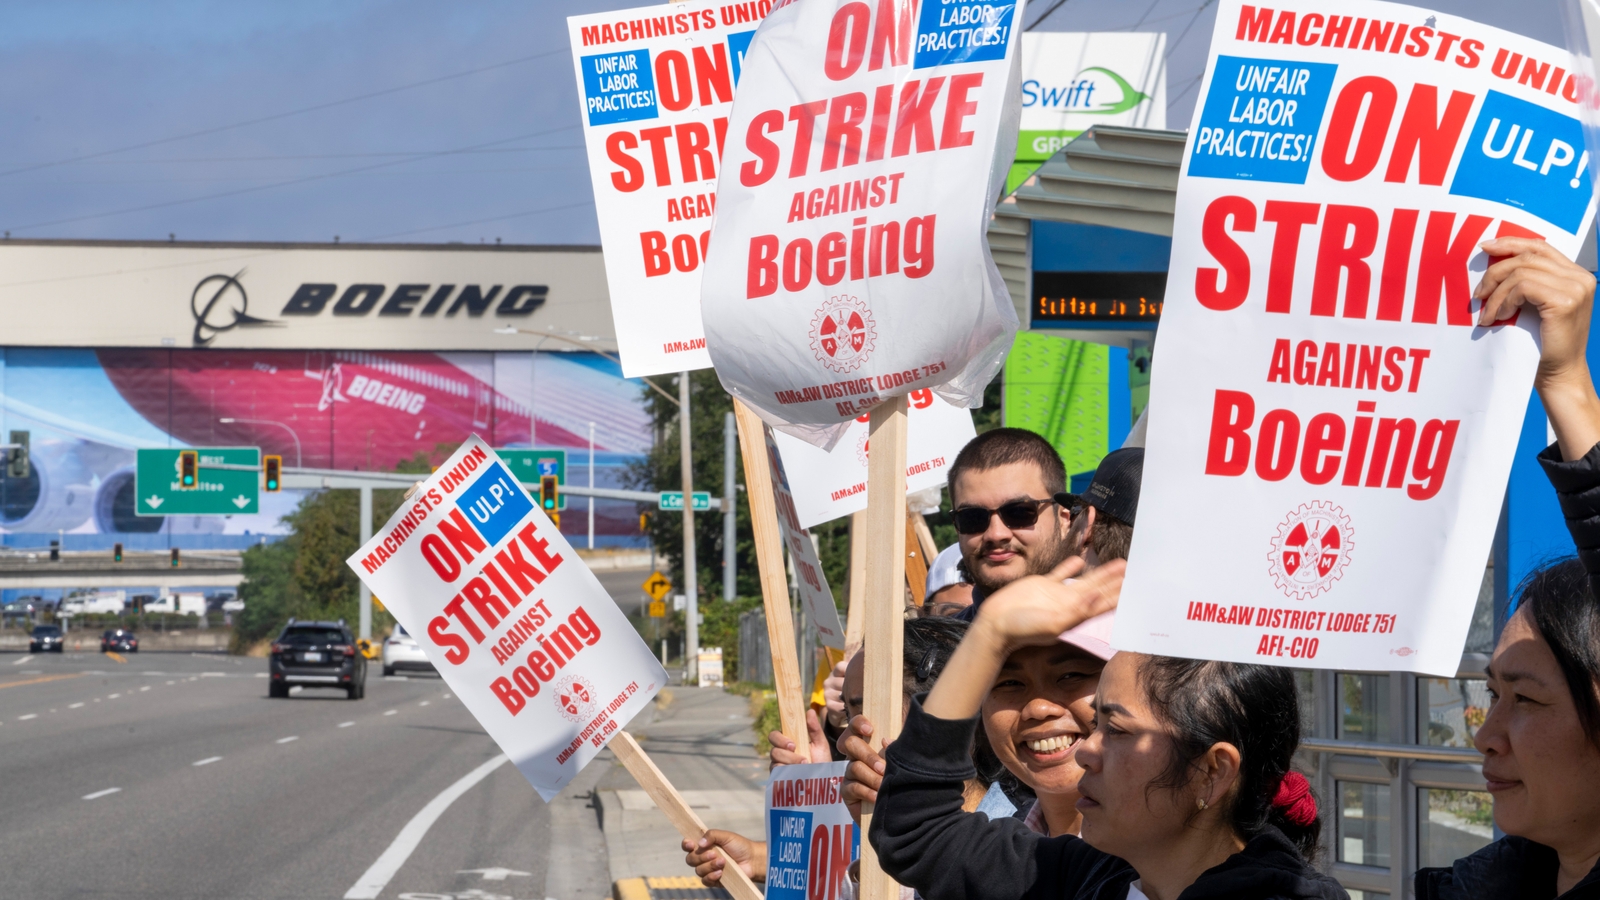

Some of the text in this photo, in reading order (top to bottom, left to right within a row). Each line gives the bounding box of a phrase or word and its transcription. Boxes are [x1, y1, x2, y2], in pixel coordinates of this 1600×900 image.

[581, 0, 773, 46] MACHINISTS UNIO
[940, 5, 990, 27] LABOR
[824, 0, 917, 82] ON
[917, 26, 1008, 53] PRACTICES!
[1235, 4, 1597, 105] MACHINISTS UNIO
[595, 54, 638, 74] UNFAIR
[599, 73, 639, 93] LABOR
[655, 42, 733, 112] ON
[1235, 64, 1311, 96] UNFAIR
[587, 90, 655, 113] PRACTICES!
[1022, 79, 1095, 108] Swift
[1228, 95, 1297, 127] LABOR
[740, 72, 984, 188] STRIKE
[1195, 127, 1312, 163] PRACTICES!
[1320, 75, 1476, 187] ON
[1481, 117, 1590, 190] ULP!
[787, 173, 905, 224] AGAINST
[746, 213, 937, 300] Boeing
[281, 283, 549, 317] BOEING
[663, 338, 706, 354] IAM&AW
[1266, 338, 1431, 394] AGAINST
[346, 374, 426, 415] BOEING
[774, 386, 822, 405] IAM&AW
[822, 377, 875, 401] DISTRICT
[877, 367, 922, 392] LODGE
[923, 361, 947, 377] 751
[1204, 388, 1461, 501] Boeing
[831, 456, 946, 502] IAM&AW LODGE 751
[360, 445, 488, 575] MACHINISTS UNION
[469, 477, 515, 524] ULP!
[1311, 510, 1341, 524] MACHINISTS
[420, 507, 487, 583] ON
[1286, 554, 1332, 569] A M
[427, 521, 564, 666] STRIKE
[490, 598, 553, 666] AGAINST
[1186, 601, 1397, 634] IAM&AW DISTRICT LODGE 751
[488, 605, 602, 717] Boeing
[1256, 634, 1320, 660] AFL-CIO
[556, 681, 640, 765] IAM&AW DISTRICT LODGE 751
[591, 719, 618, 748] AFL-CIO
[772, 776, 846, 808] MACHINIST
[780, 816, 806, 838] UNFAIR
[779, 842, 802, 863] LABOR
[808, 824, 853, 900] ON
[768, 866, 807, 890] PRACTICES!
